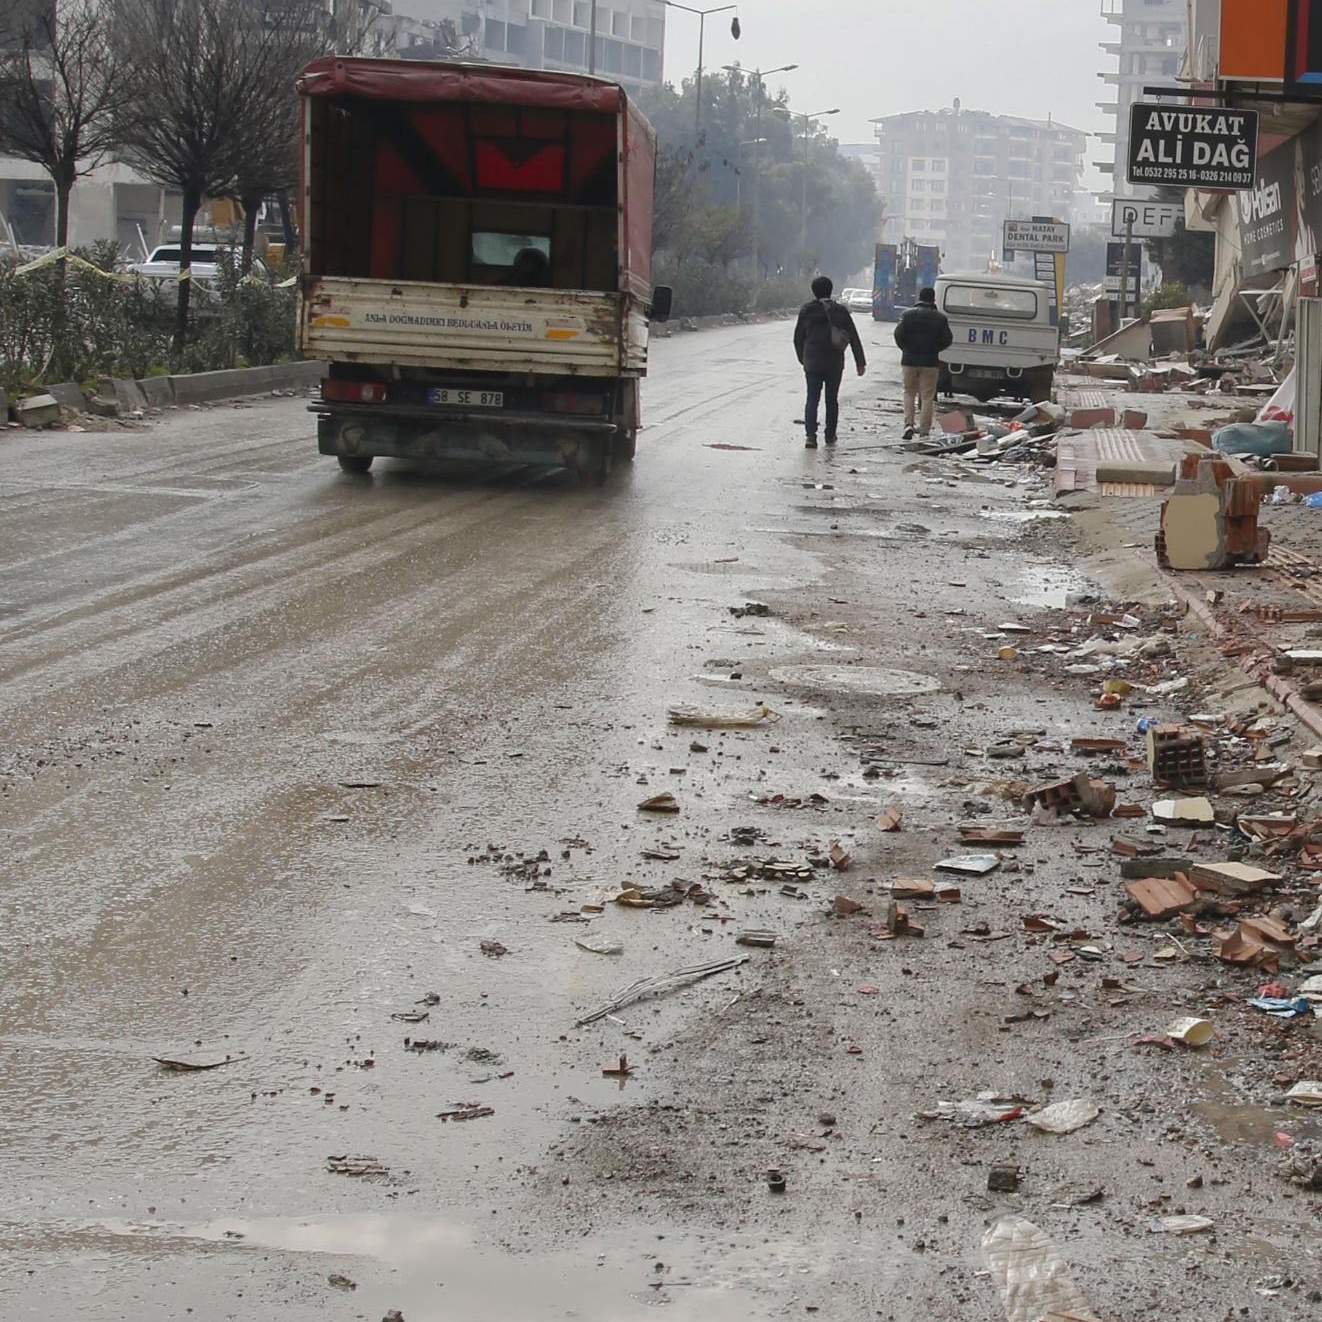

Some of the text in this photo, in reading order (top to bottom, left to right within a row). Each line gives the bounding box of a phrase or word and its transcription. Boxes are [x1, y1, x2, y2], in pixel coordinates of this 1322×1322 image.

[1145, 111, 1244, 136] AVUKAT
[1136, 134, 1249, 168] ALİ DAĞ
[1008, 233, 1064, 243] DENTAL PARK
[968, 328, 1008, 345] BMC
[458, 391, 471, 404] SE
